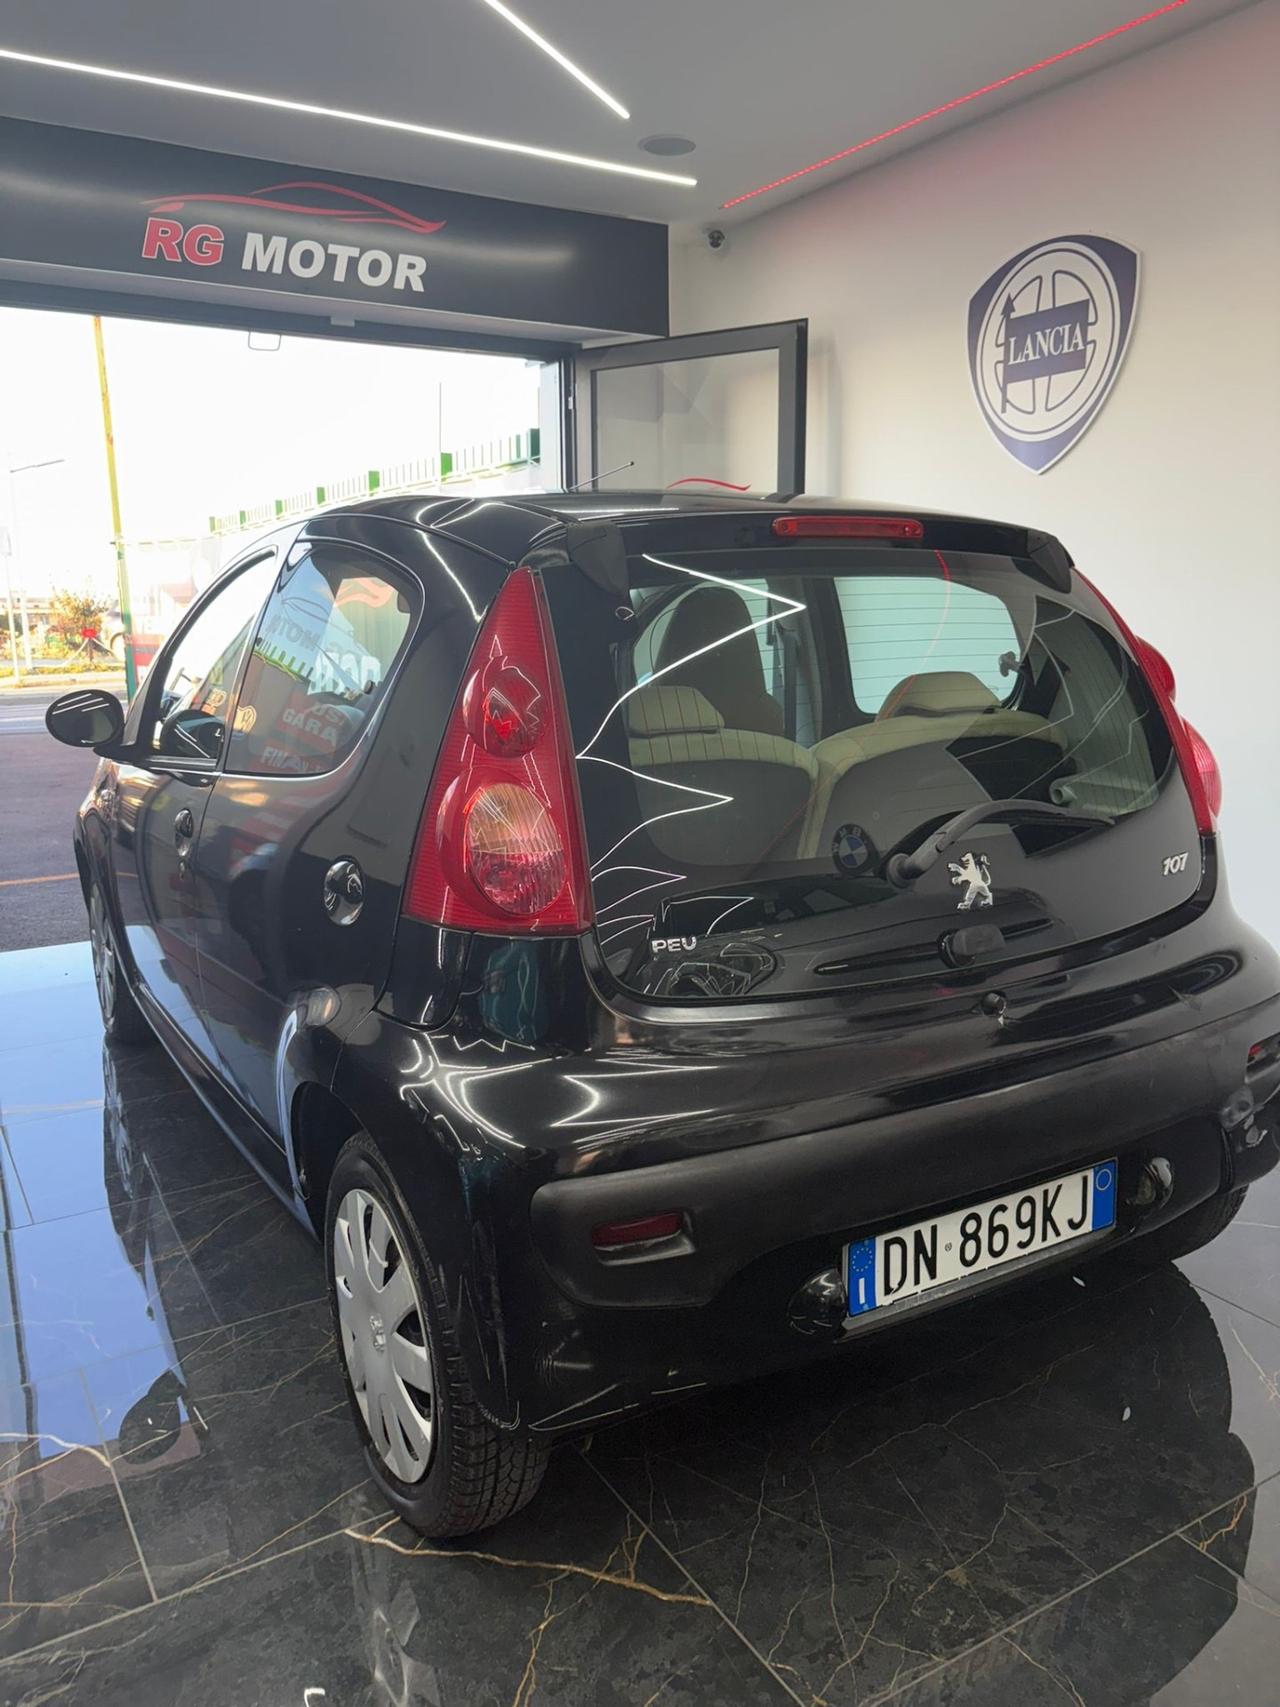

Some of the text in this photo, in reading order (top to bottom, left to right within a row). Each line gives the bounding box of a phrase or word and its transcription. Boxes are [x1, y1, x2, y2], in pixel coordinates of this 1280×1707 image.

[142, 217, 427, 292] RG MOTOR
[1007, 322, 1085, 365] LANCIA
[1163, 851, 1189, 876] 107
[651, 936, 697, 953] PEU
[884, 1224, 938, 1297] DN
[959, 1175, 1089, 1268] 869KJ
